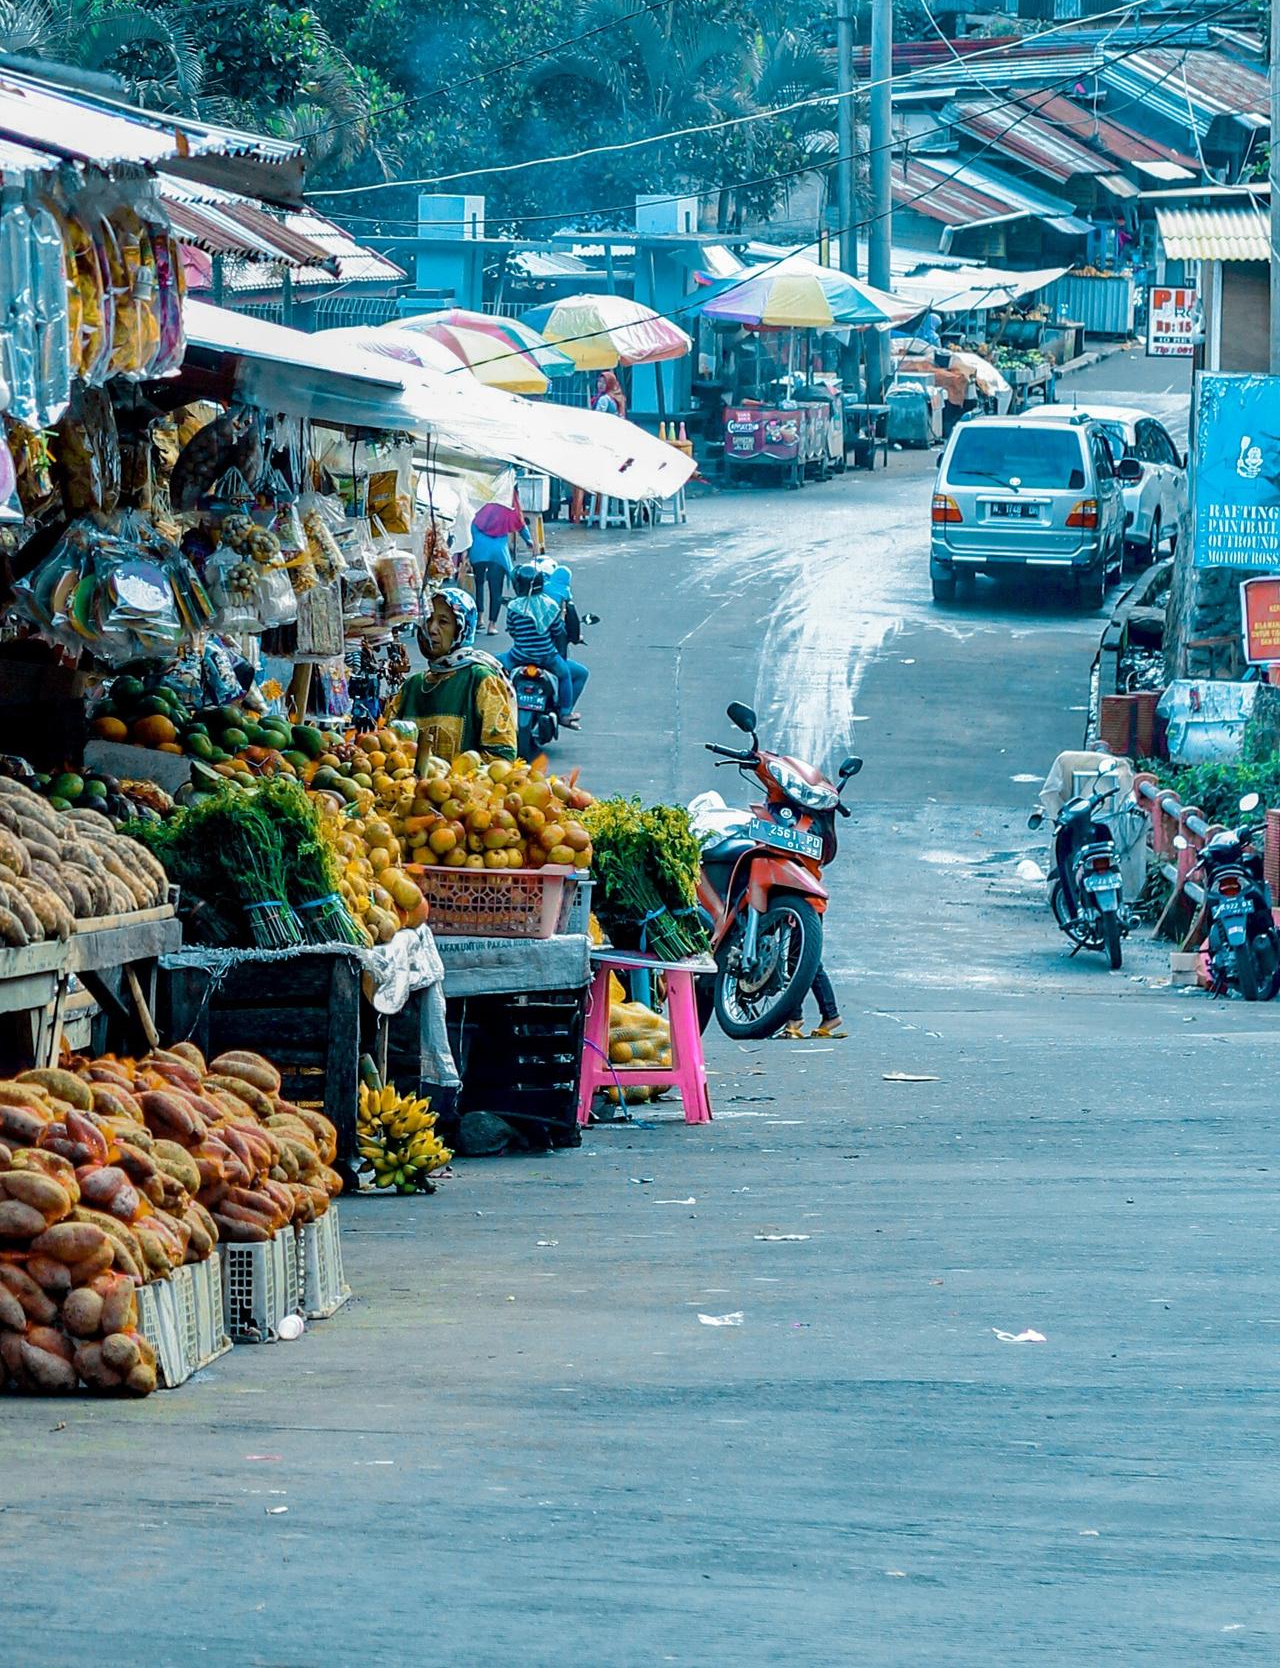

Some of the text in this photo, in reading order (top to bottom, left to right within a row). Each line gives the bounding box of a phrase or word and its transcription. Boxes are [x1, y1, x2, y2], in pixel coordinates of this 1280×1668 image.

[1209, 504, 1279, 520] RAFTING
[1208, 518, 1279, 535] PAINTBALL
[1208, 534, 1279, 550] OUTBOUND
[1207, 549, 1279, 565] MOTORCROSS
[752, 819, 761, 829] W
[770, 825, 797, 840] 2561
